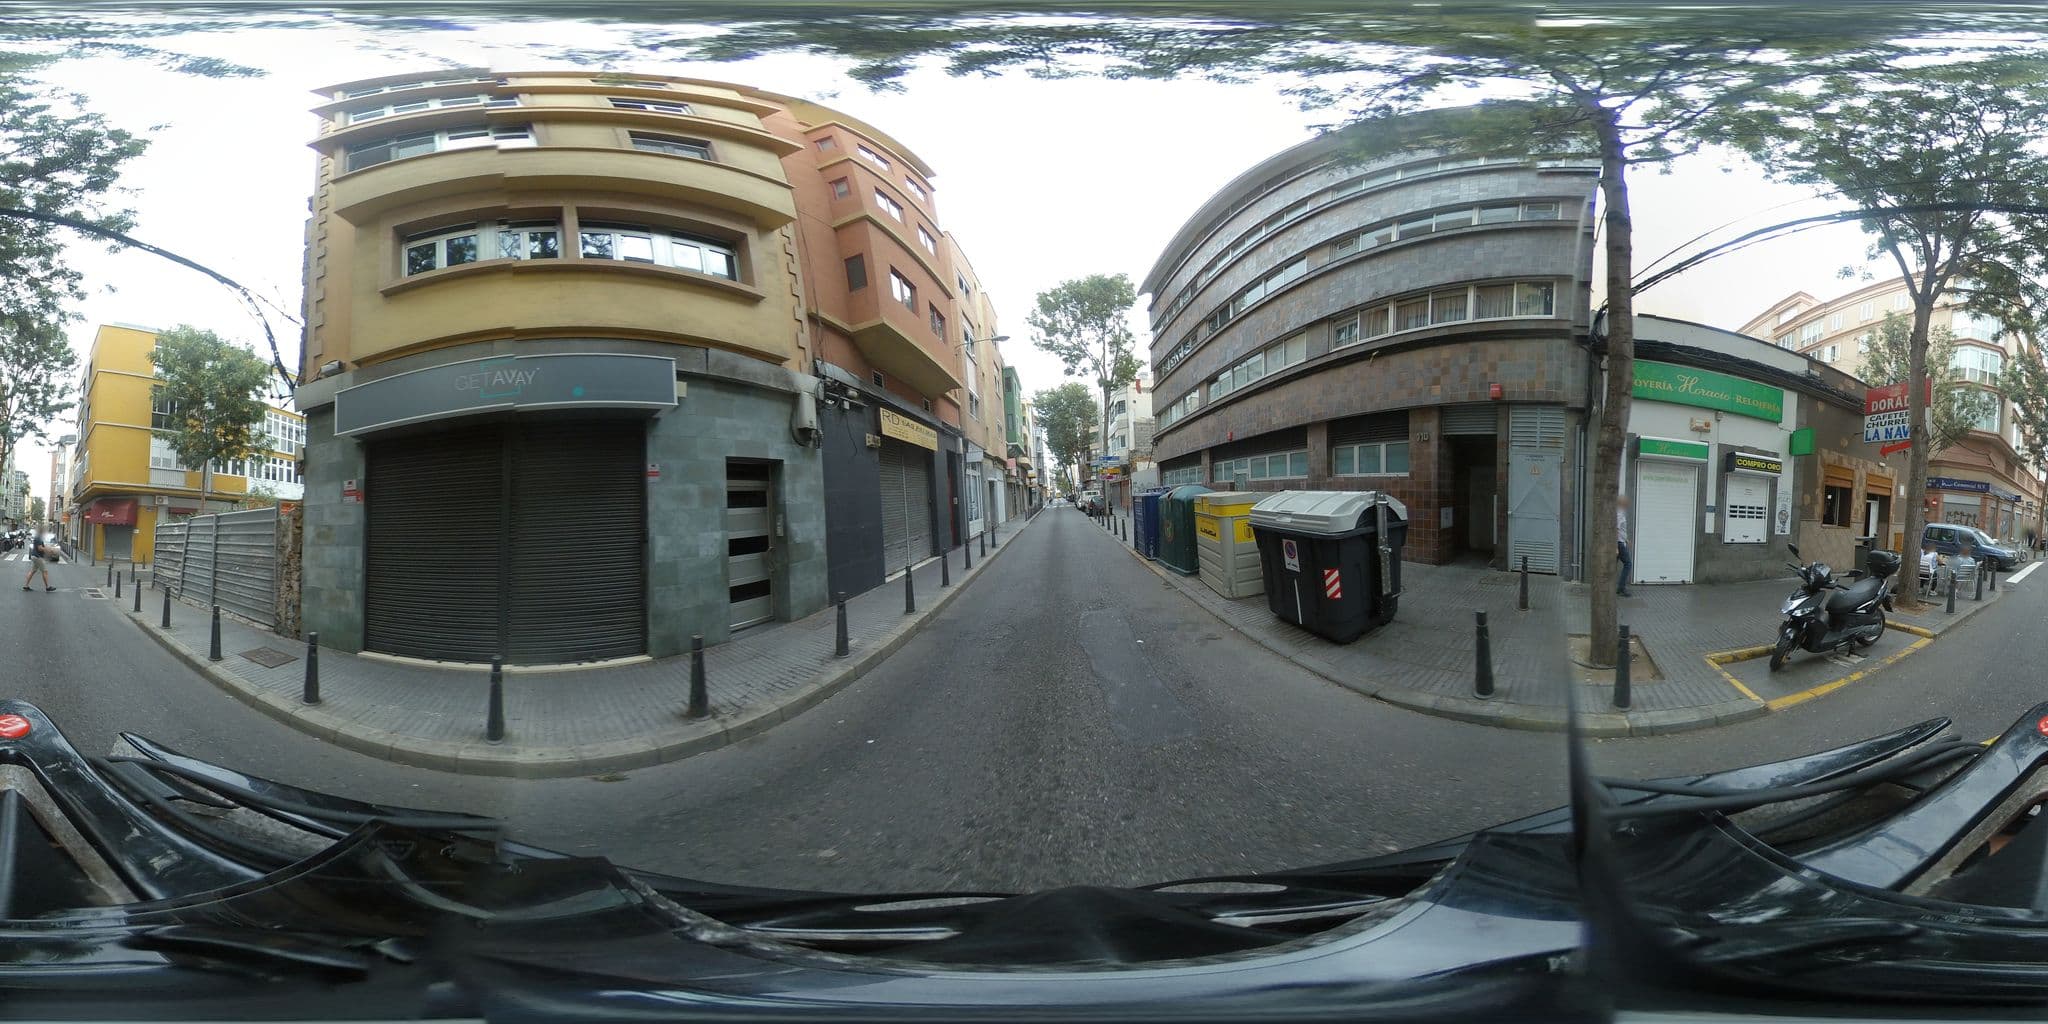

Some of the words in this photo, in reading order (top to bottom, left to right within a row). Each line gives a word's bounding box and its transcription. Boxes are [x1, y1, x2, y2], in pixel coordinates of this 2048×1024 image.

[1633, 378, 1673, 392] OYERÍA
[1677, 374, 1730, 401] Horacio
[1864, 428, 1880, 441] LA
[1885, 425, 1910, 439] NAV
[1736, 458, 1766, 469] COMPRO
[1767, 463, 1781, 471] ORO
